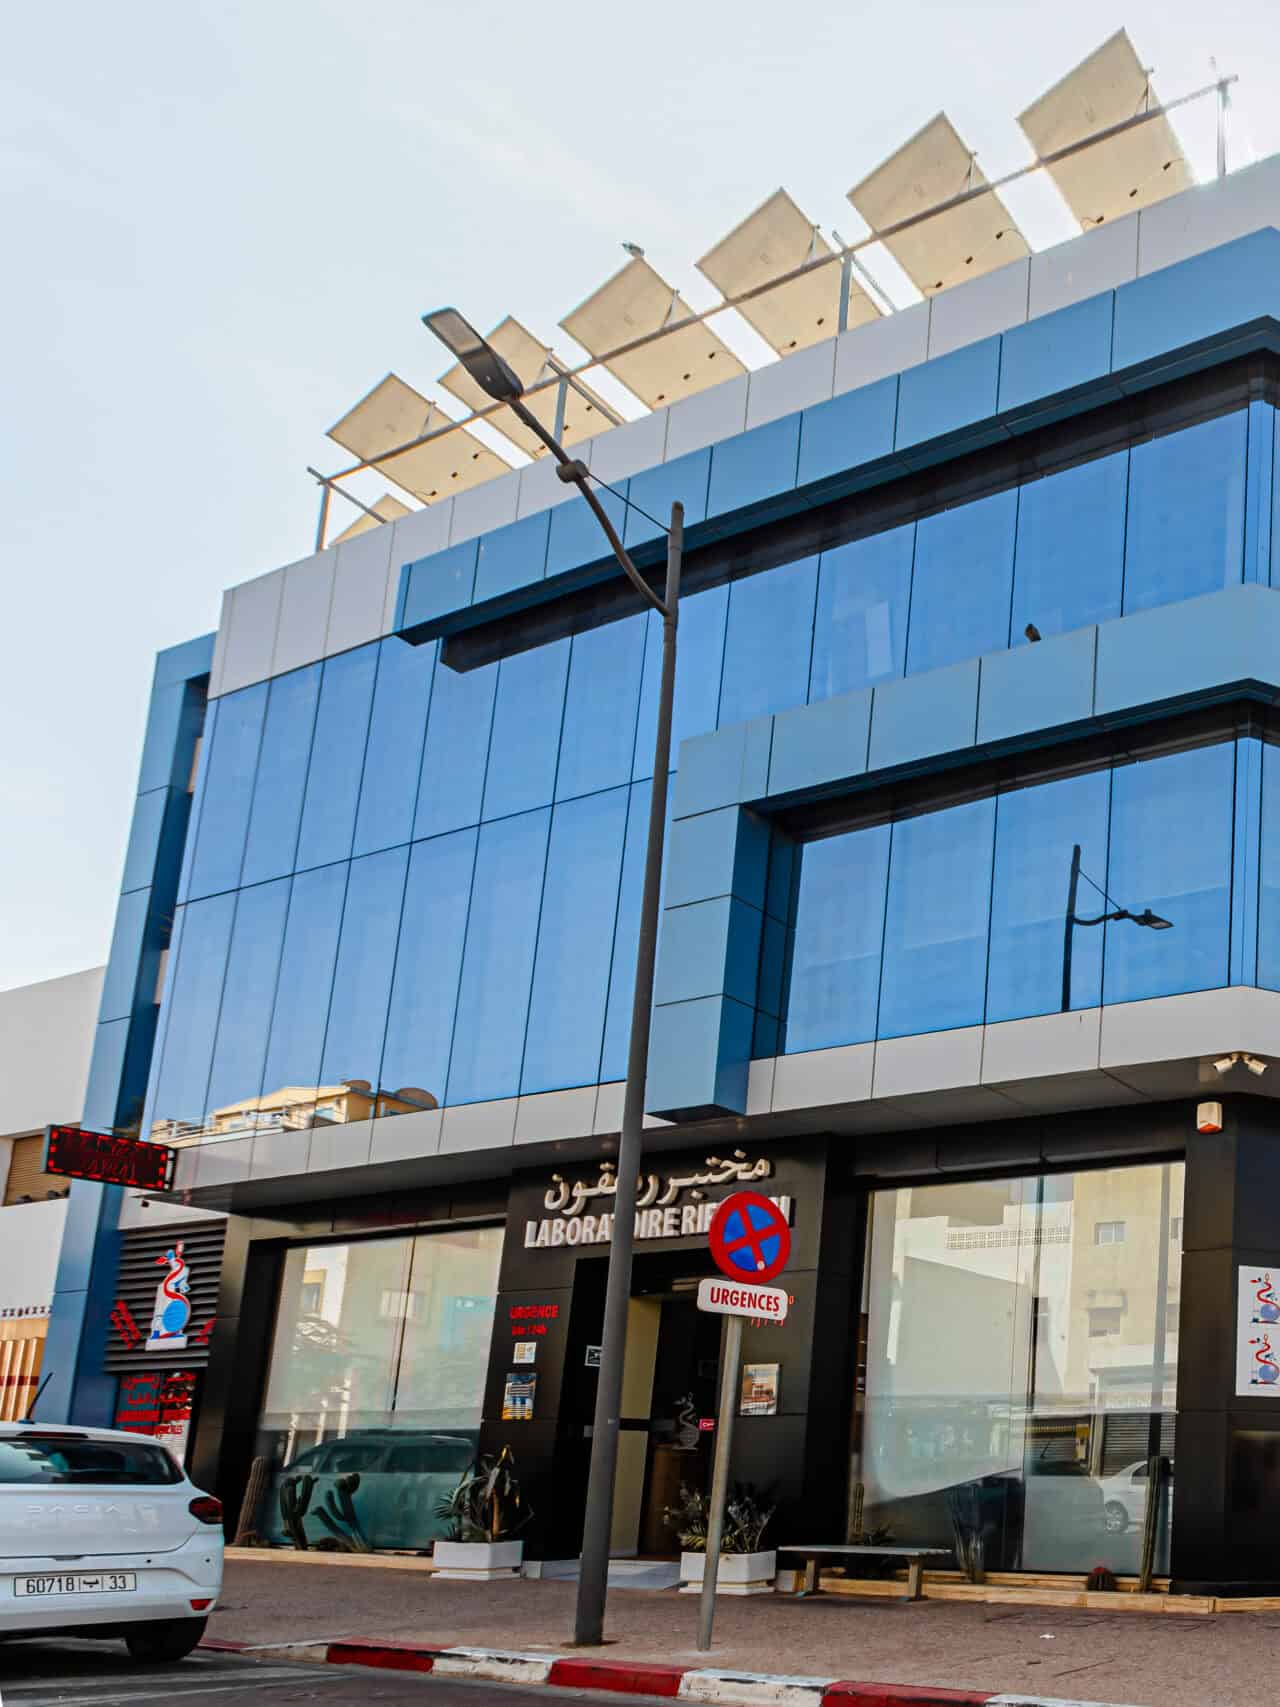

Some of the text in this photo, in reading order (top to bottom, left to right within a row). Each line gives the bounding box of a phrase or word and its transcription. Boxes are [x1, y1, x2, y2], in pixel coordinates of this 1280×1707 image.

[656, 1149, 771, 1205] مختبر
[524, 1207, 681, 1249] LABORAIRE
[710, 1287, 780, 1312] URGENCES
[26, 1577, 75, 1594] 60718
[109, 1575, 127, 1590] 33
